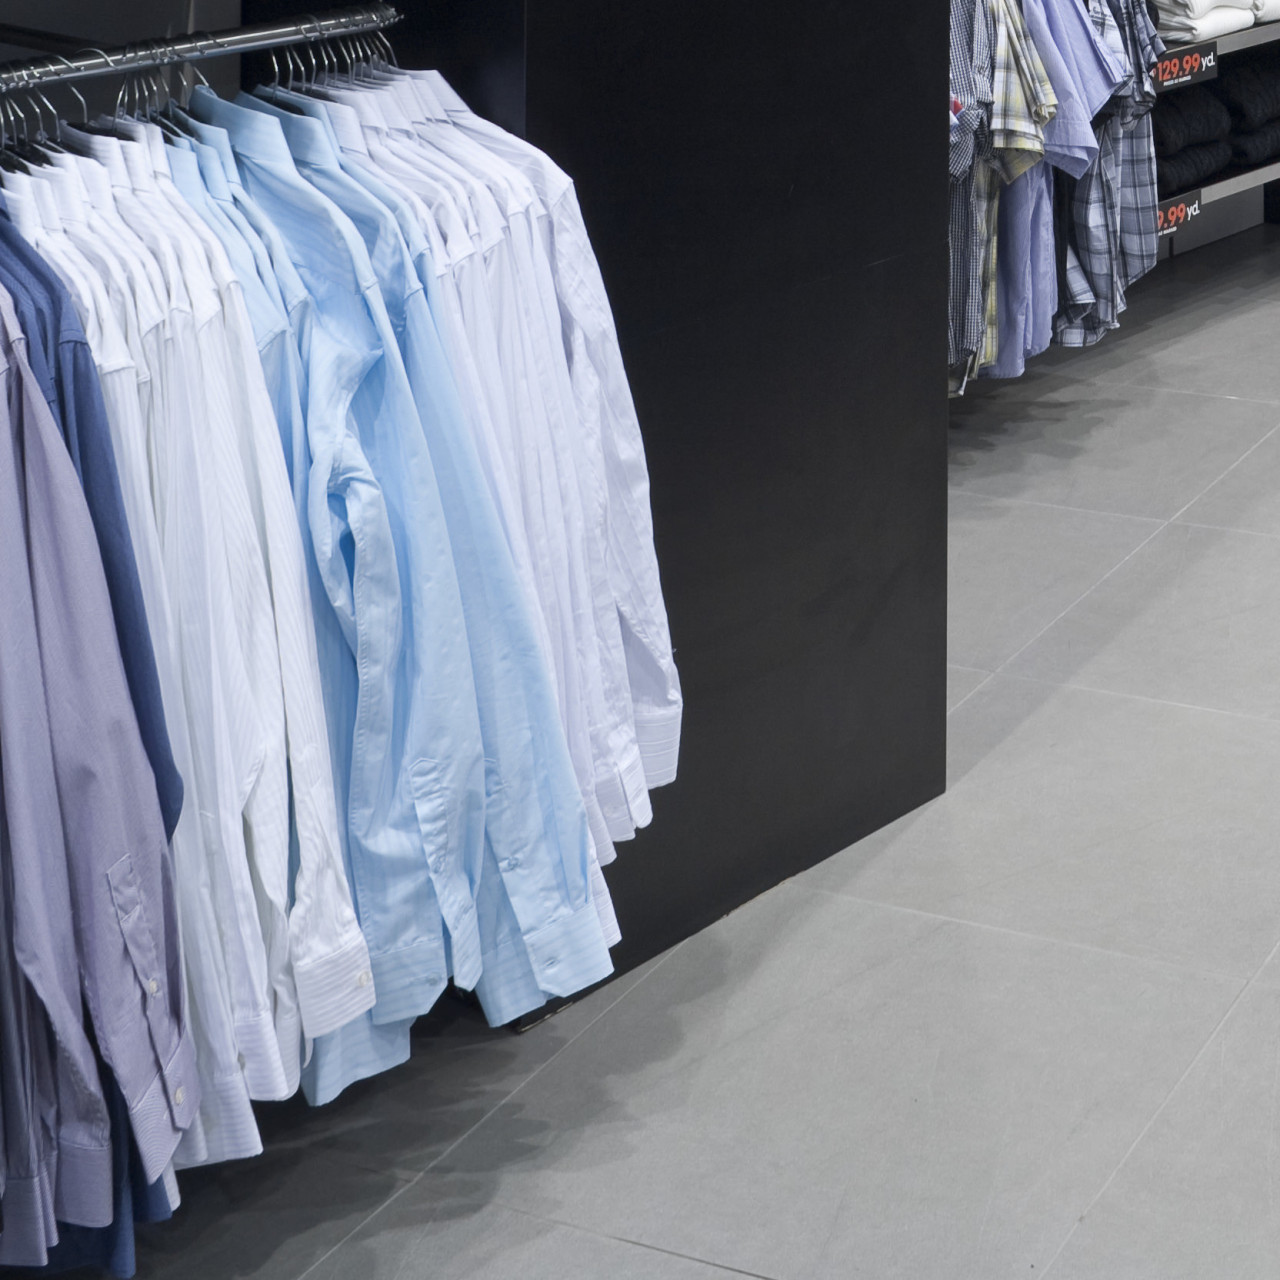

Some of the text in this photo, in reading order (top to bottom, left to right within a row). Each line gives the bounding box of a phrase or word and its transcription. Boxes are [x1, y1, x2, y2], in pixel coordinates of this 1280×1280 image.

[1201, 52, 1215, 71] yd.
[1157, 200, 1200, 230] 9.99 yd.
